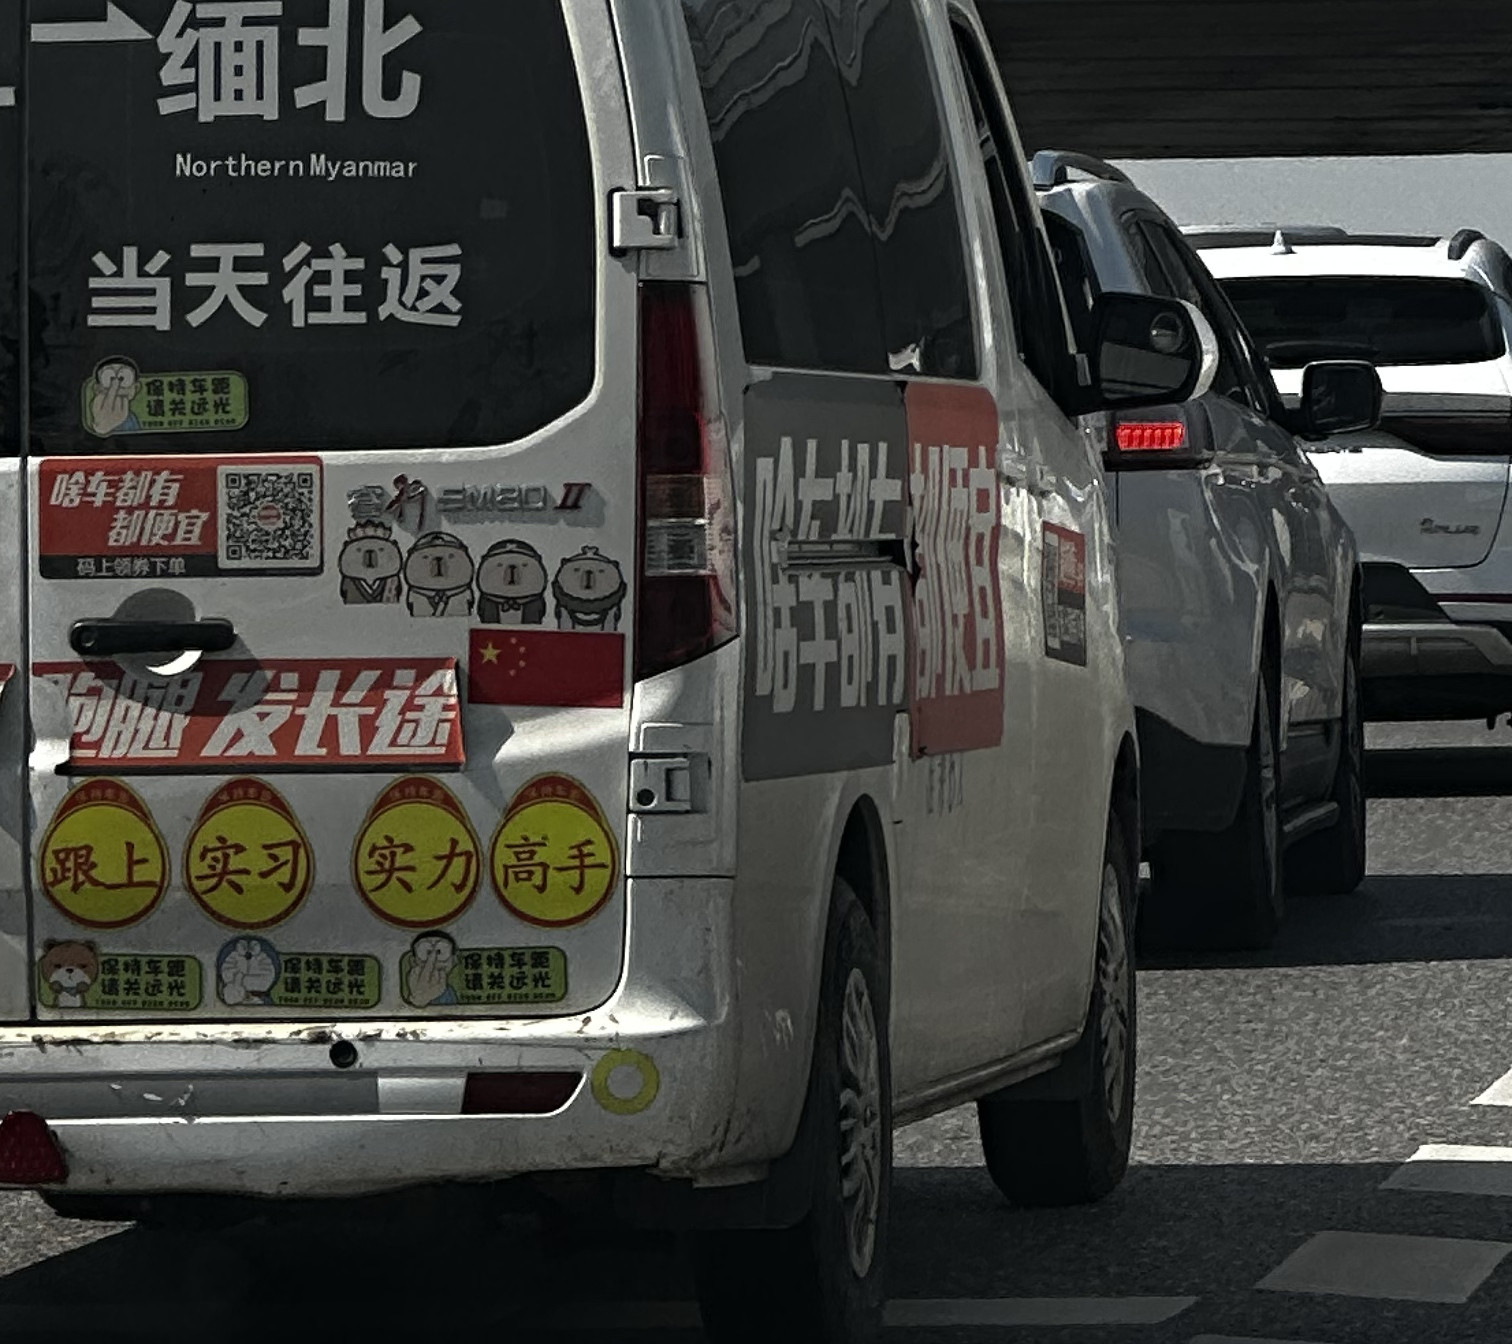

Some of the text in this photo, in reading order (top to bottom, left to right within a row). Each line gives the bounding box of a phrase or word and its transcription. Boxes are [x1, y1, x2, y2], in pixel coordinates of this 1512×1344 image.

[175, 152, 419, 182] Northern Myanmar
[87, 242, 464, 331] 当天往返
[49, 470, 185, 508] 啥车都有
[107, 509, 211, 546] 都便宜
[201, 666, 458, 758] 发长途
[48, 840, 162, 894] 跟上
[194, 835, 304, 896] 实习
[363, 835, 477, 896] 实力
[501, 834, 611, 896] 高手
